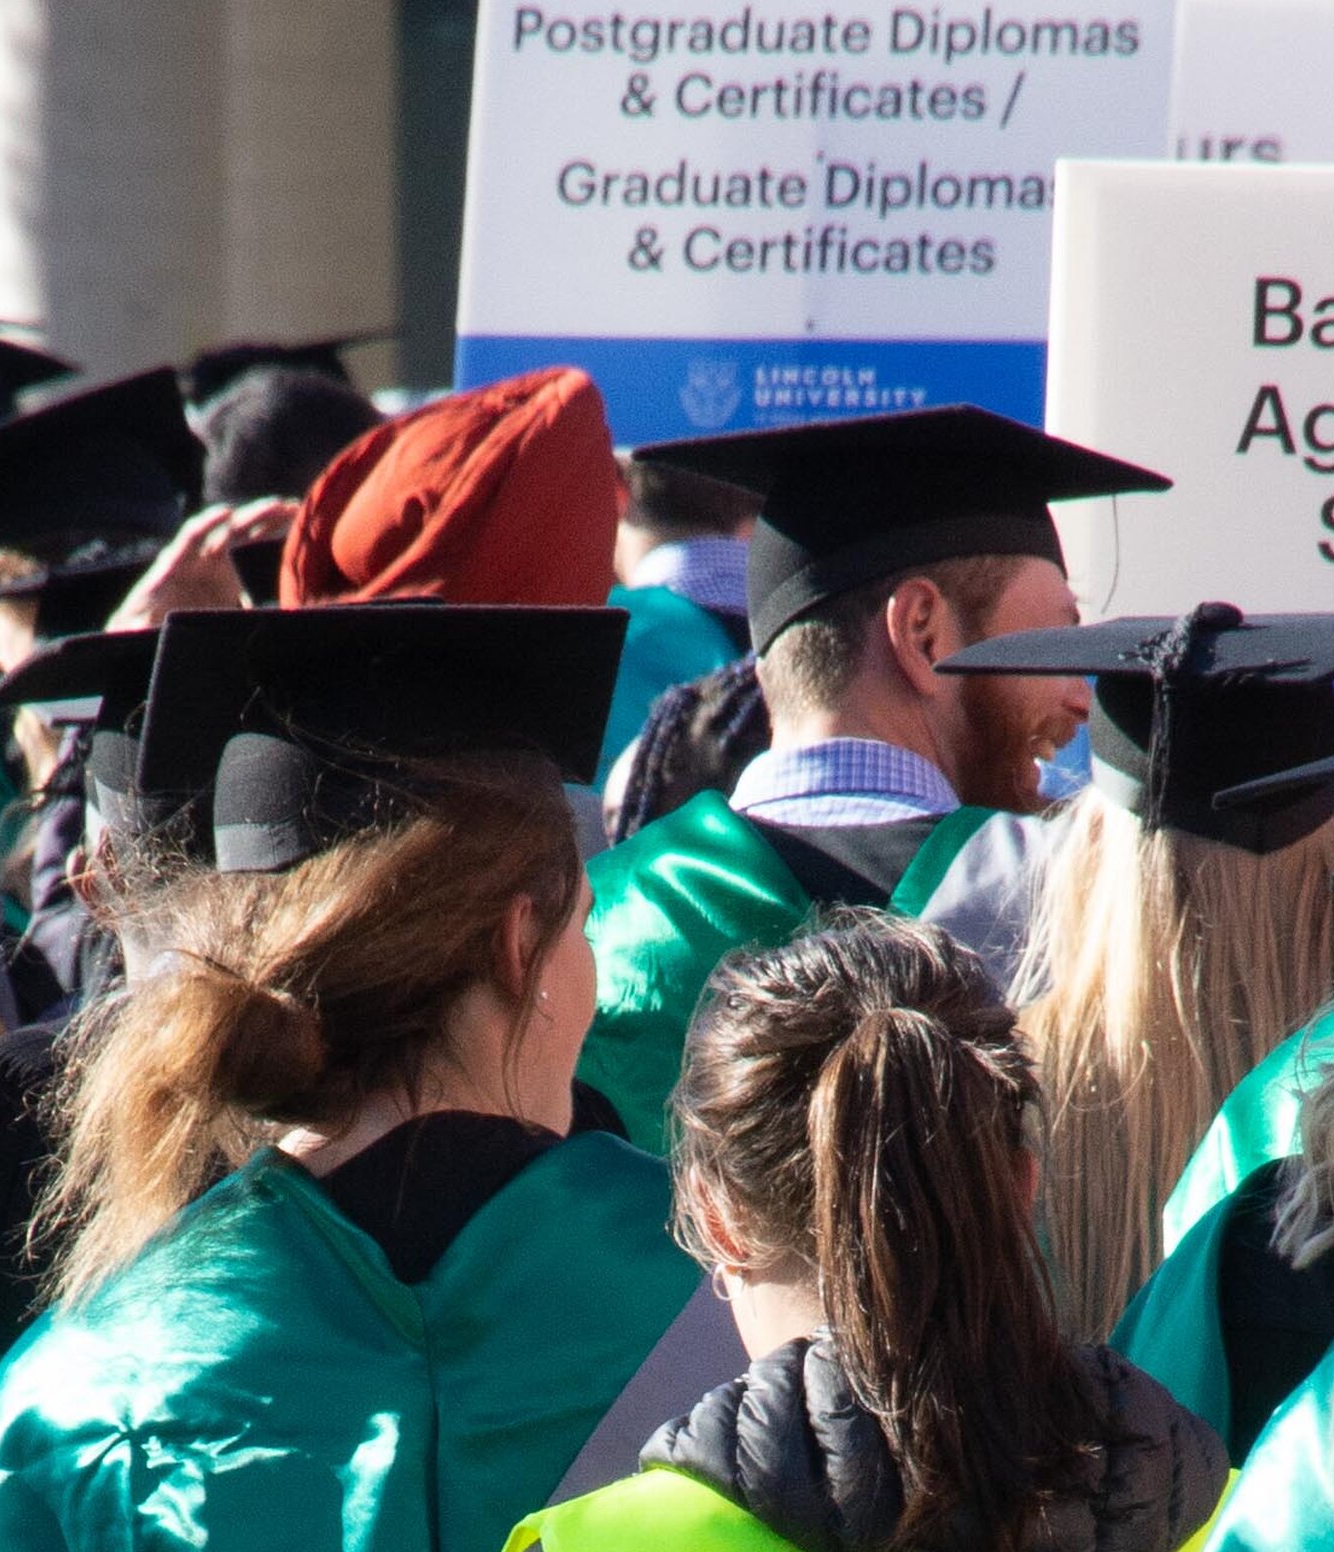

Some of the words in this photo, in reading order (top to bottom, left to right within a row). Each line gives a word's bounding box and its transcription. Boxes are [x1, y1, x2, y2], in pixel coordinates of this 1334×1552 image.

[513, 6, 871, 62] Postgraduate
[889, 7, 1141, 65] Diplomas
[620, 72, 655, 119] &
[675, 72, 987, 121] Certificates
[999, 71, 1025, 130] /
[557, 160, 808, 210] Graduate
[628, 227, 664, 273] &
[683, 225, 997, 276] Certificates
[754, 365, 877, 387] LINCOLN
[754, 387, 928, 408] UNIVERSITY
